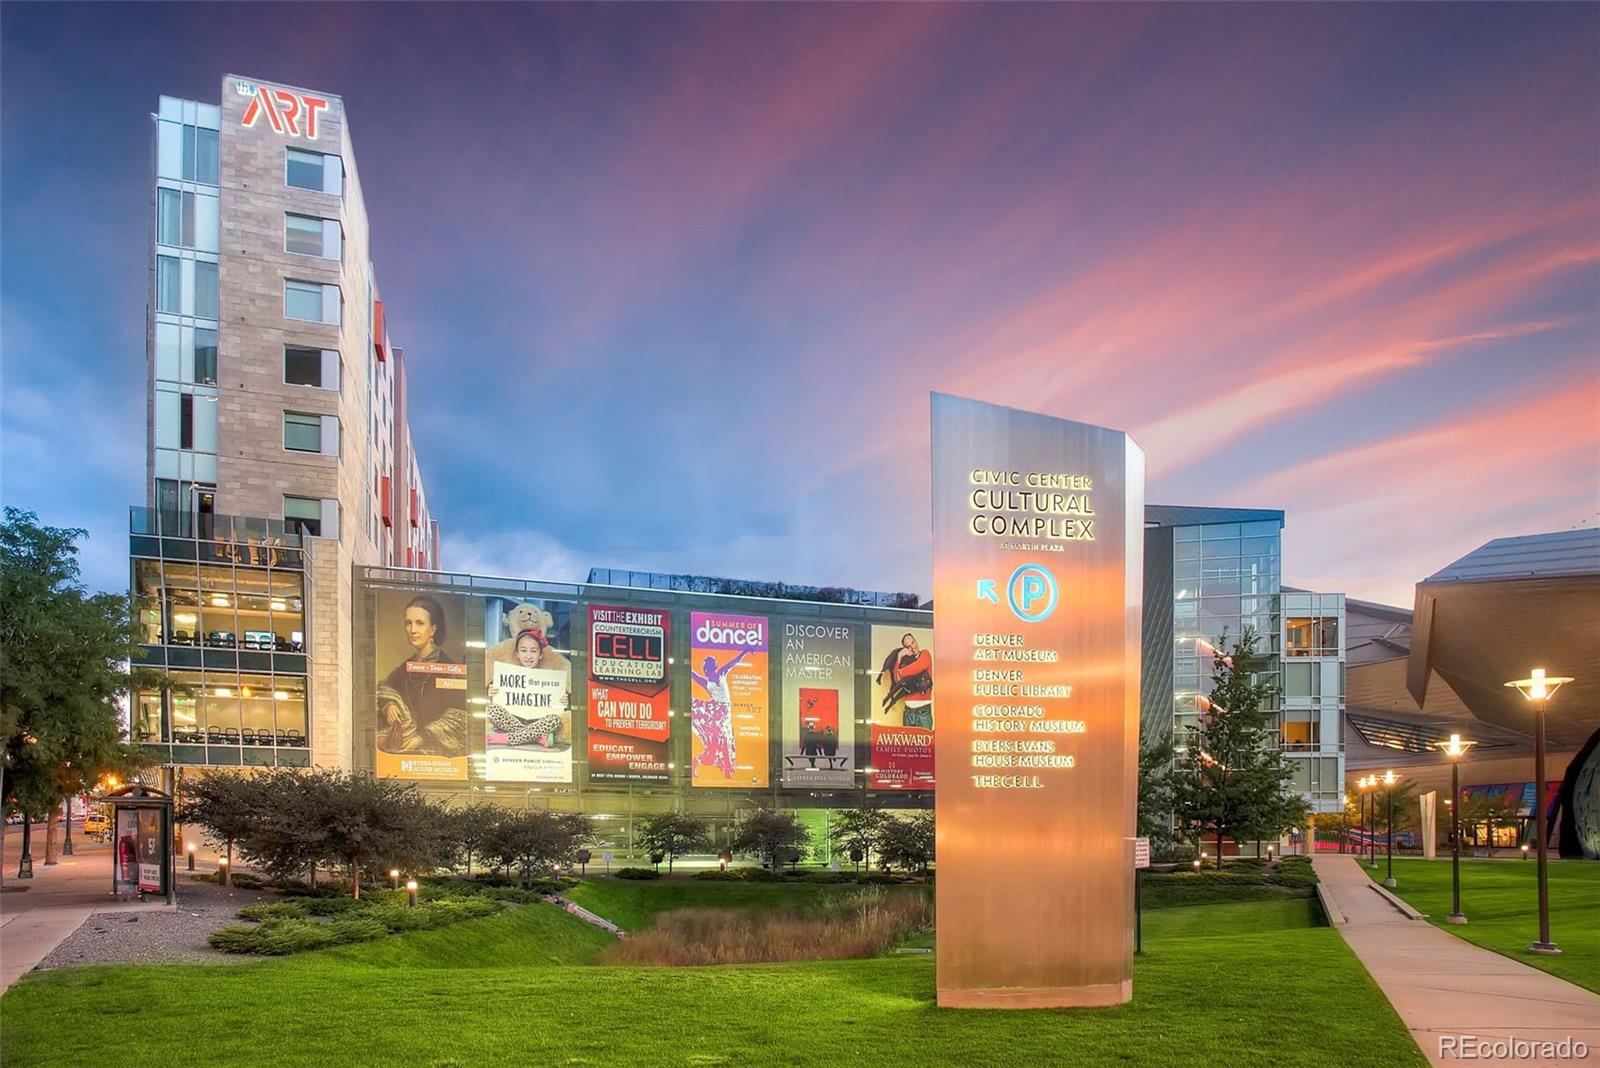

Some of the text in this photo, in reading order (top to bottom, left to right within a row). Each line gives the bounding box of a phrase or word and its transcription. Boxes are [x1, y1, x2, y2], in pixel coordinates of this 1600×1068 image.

[241, 86, 328, 139] ART
[970, 468, 1092, 490] CIVIC CENTER
[970, 488, 1094, 515] CULTURAL
[970, 514, 1094, 539] COMPLEX
[1041, 544, 1064, 552] PLAZA
[593, 610, 662, 625] VISIT THE EXHIBIT
[595, 624, 662, 635] COUNTERTERRORISM
[711, 620, 745, 629] SUMMER
[696, 620, 762, 646] dance!
[785, 624, 849, 640] DISCOVER
[785, 639, 804, 650] AN
[974, 634, 1024, 646] DENVER
[596, 634, 659, 660] CELL
[785, 653, 850, 667] AMERICAN
[974, 649, 1058, 662] ART MUSEUM
[595, 659, 662, 669] EDUCATION
[595, 667, 642, 675] LEARNING
[785, 667, 833, 680] MASTER
[974, 669, 1024, 681] DENVER
[500, 674, 526, 688] MORE
[592, 688, 608, 700] WHAT
[974, 685, 1072, 698] PUBLIC LIBRARY
[505, 691, 552, 707] IMAGINE
[597, 701, 652, 719] CAN YOU DO
[973, 704, 1045, 717] COLORADO
[605, 718, 612, 728] TO
[613, 719, 634, 729] PREVENT
[973, 720, 1086, 733] HISTORY MUSEUM
[876, 733, 932, 746] AWKWARD
[592, 744, 635, 753] EDUCATE
[606, 753, 653, 762] EMPOWER
[973, 754, 1075, 768] HOUSE MUSEUM
[629, 762, 665, 770] ENGAGE
[974, 775, 1001, 787] THE
